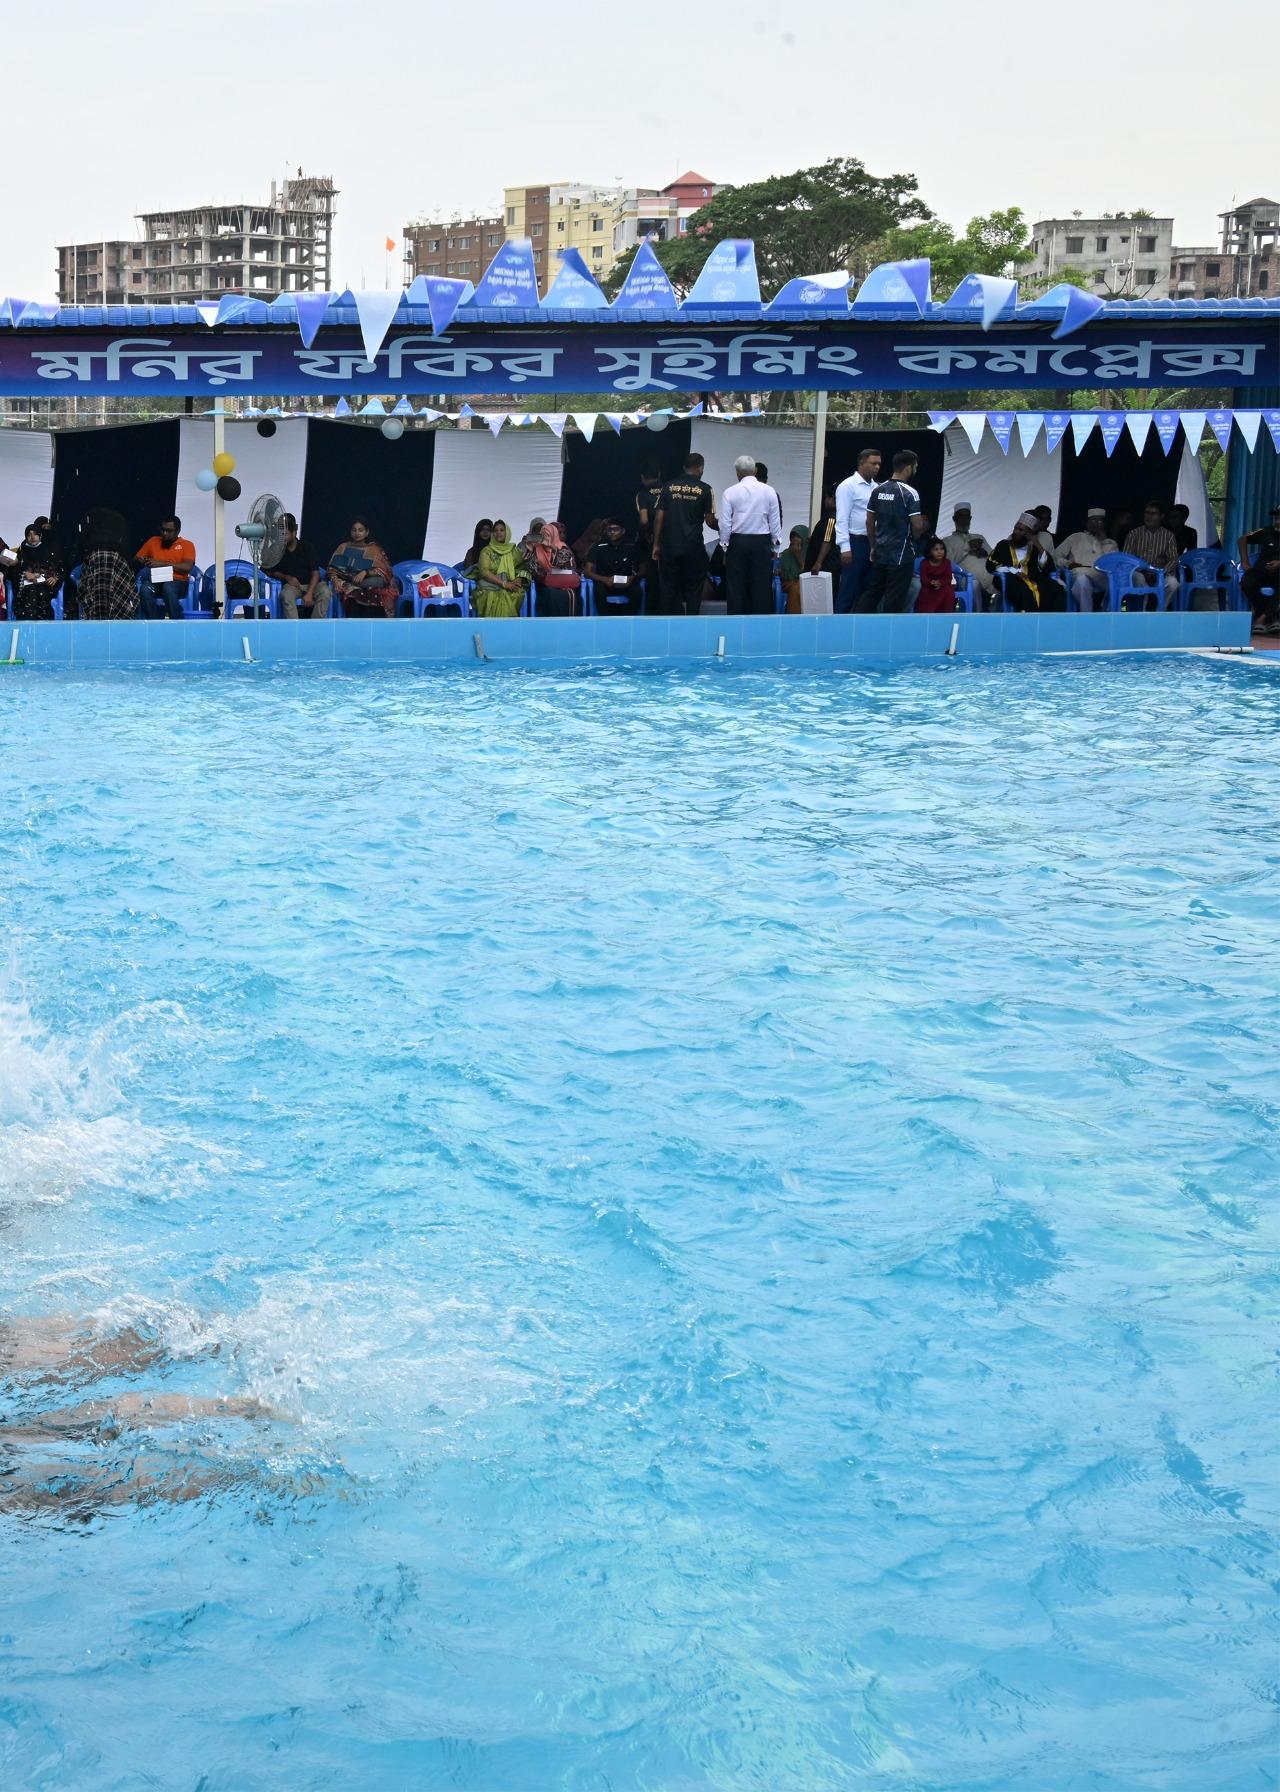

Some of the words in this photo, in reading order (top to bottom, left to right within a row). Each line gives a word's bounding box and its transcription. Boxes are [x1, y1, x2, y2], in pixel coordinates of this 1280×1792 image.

[31, 338, 263, 385] মনির
[294, 336, 563, 382] ফকির
[596, 334, 863, 389] সুইমিং
[894, 340, 1265, 379] কমপ্লেক্স
